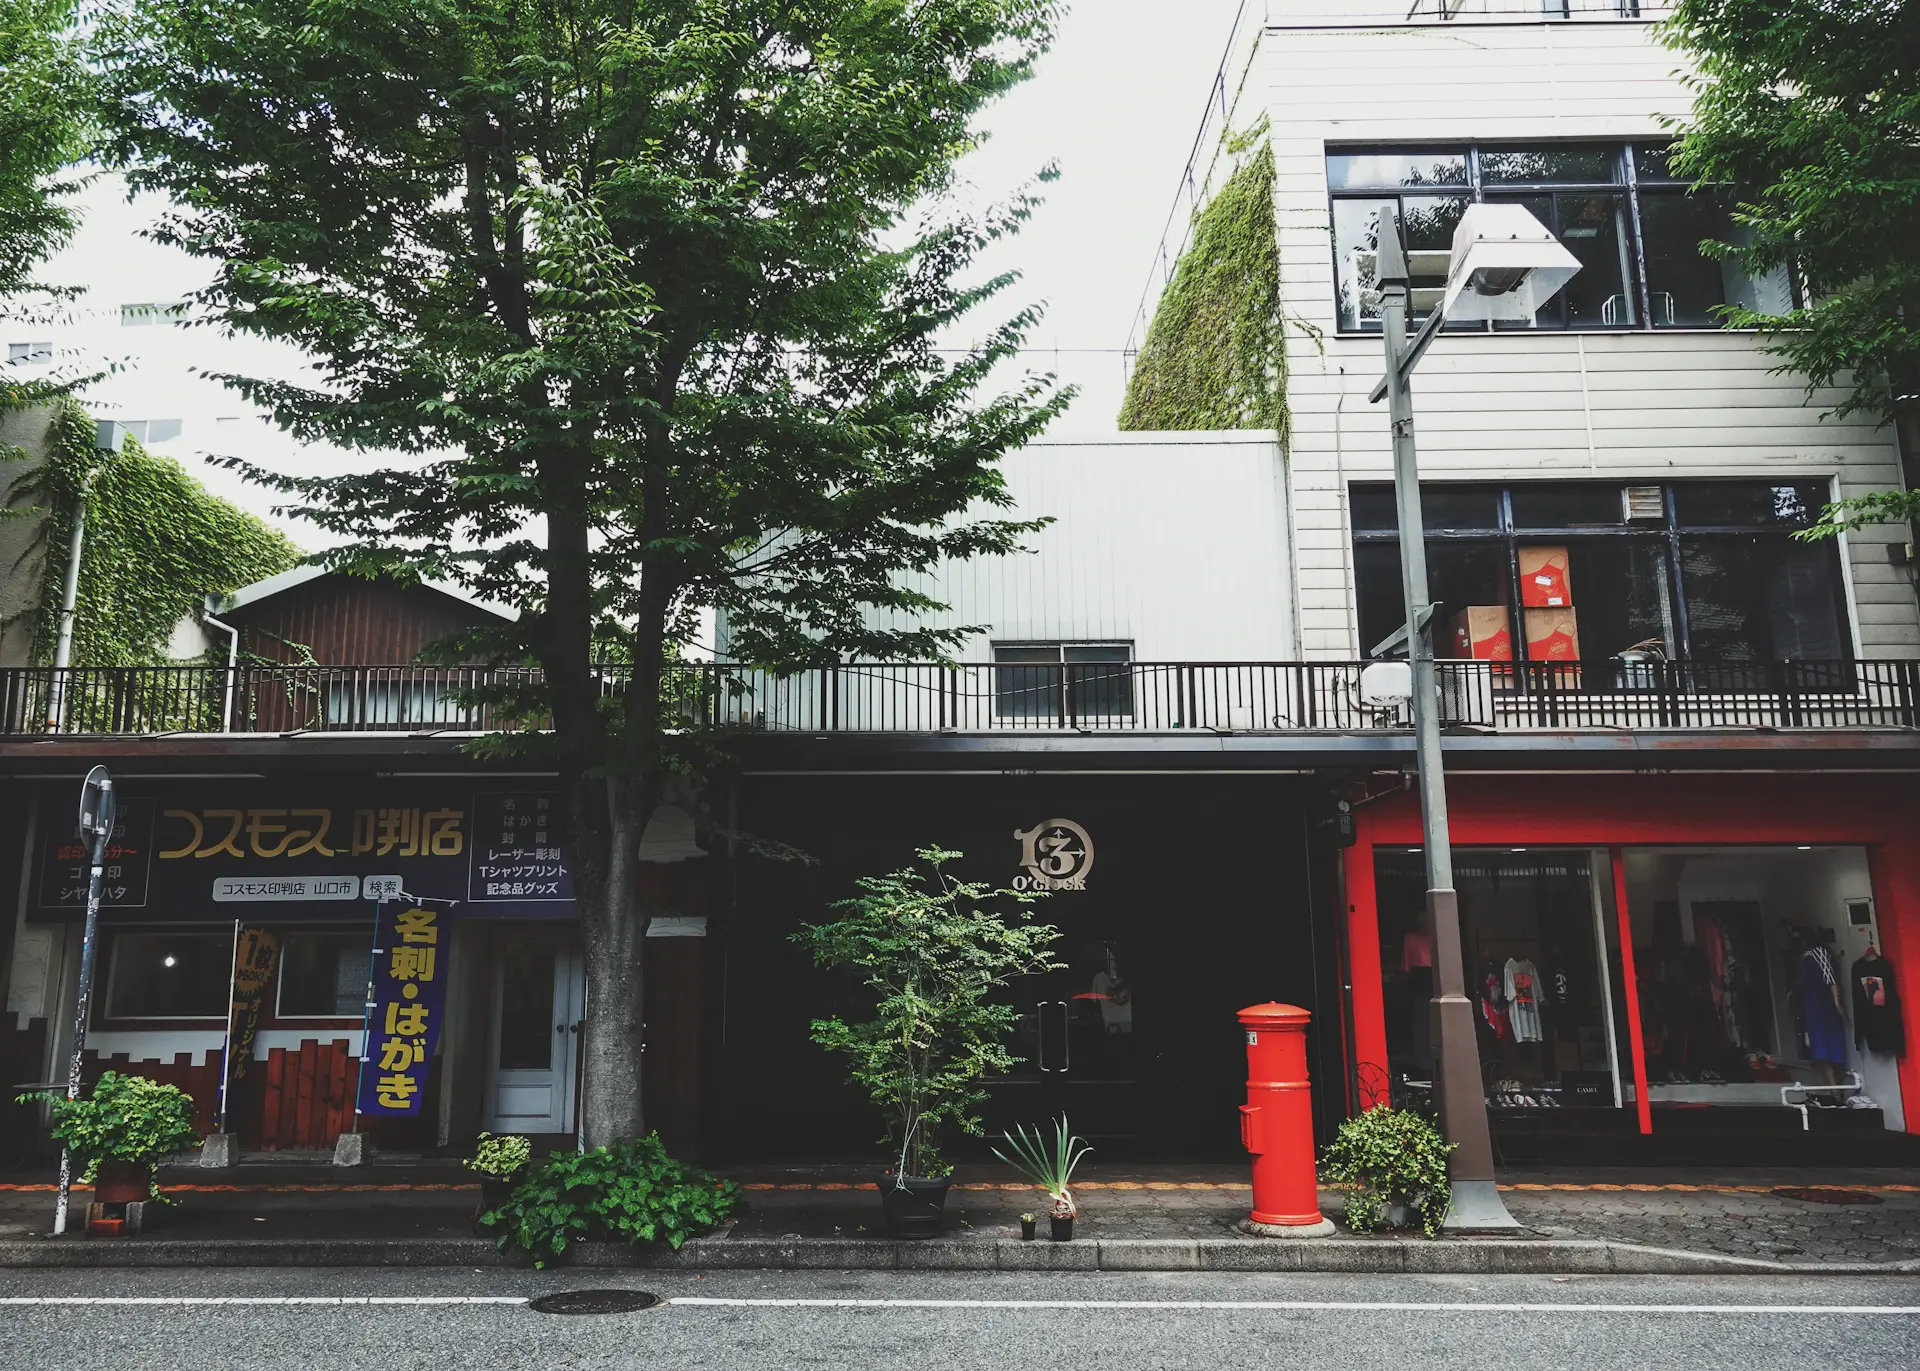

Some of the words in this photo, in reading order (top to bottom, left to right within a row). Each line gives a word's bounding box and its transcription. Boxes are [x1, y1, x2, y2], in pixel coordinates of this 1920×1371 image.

[488, 847, 561, 861] レーザー彫刻
[478, 865, 568, 878] Tシャツプリント
[222, 882, 306, 896] コスモス印判店
[313, 881, 351, 895] 山口市
[368, 880, 397, 895] 検索
[486, 881, 559, 896] 記念品グッズ
[376, 908, 438, 1109] 名刺・はがき
